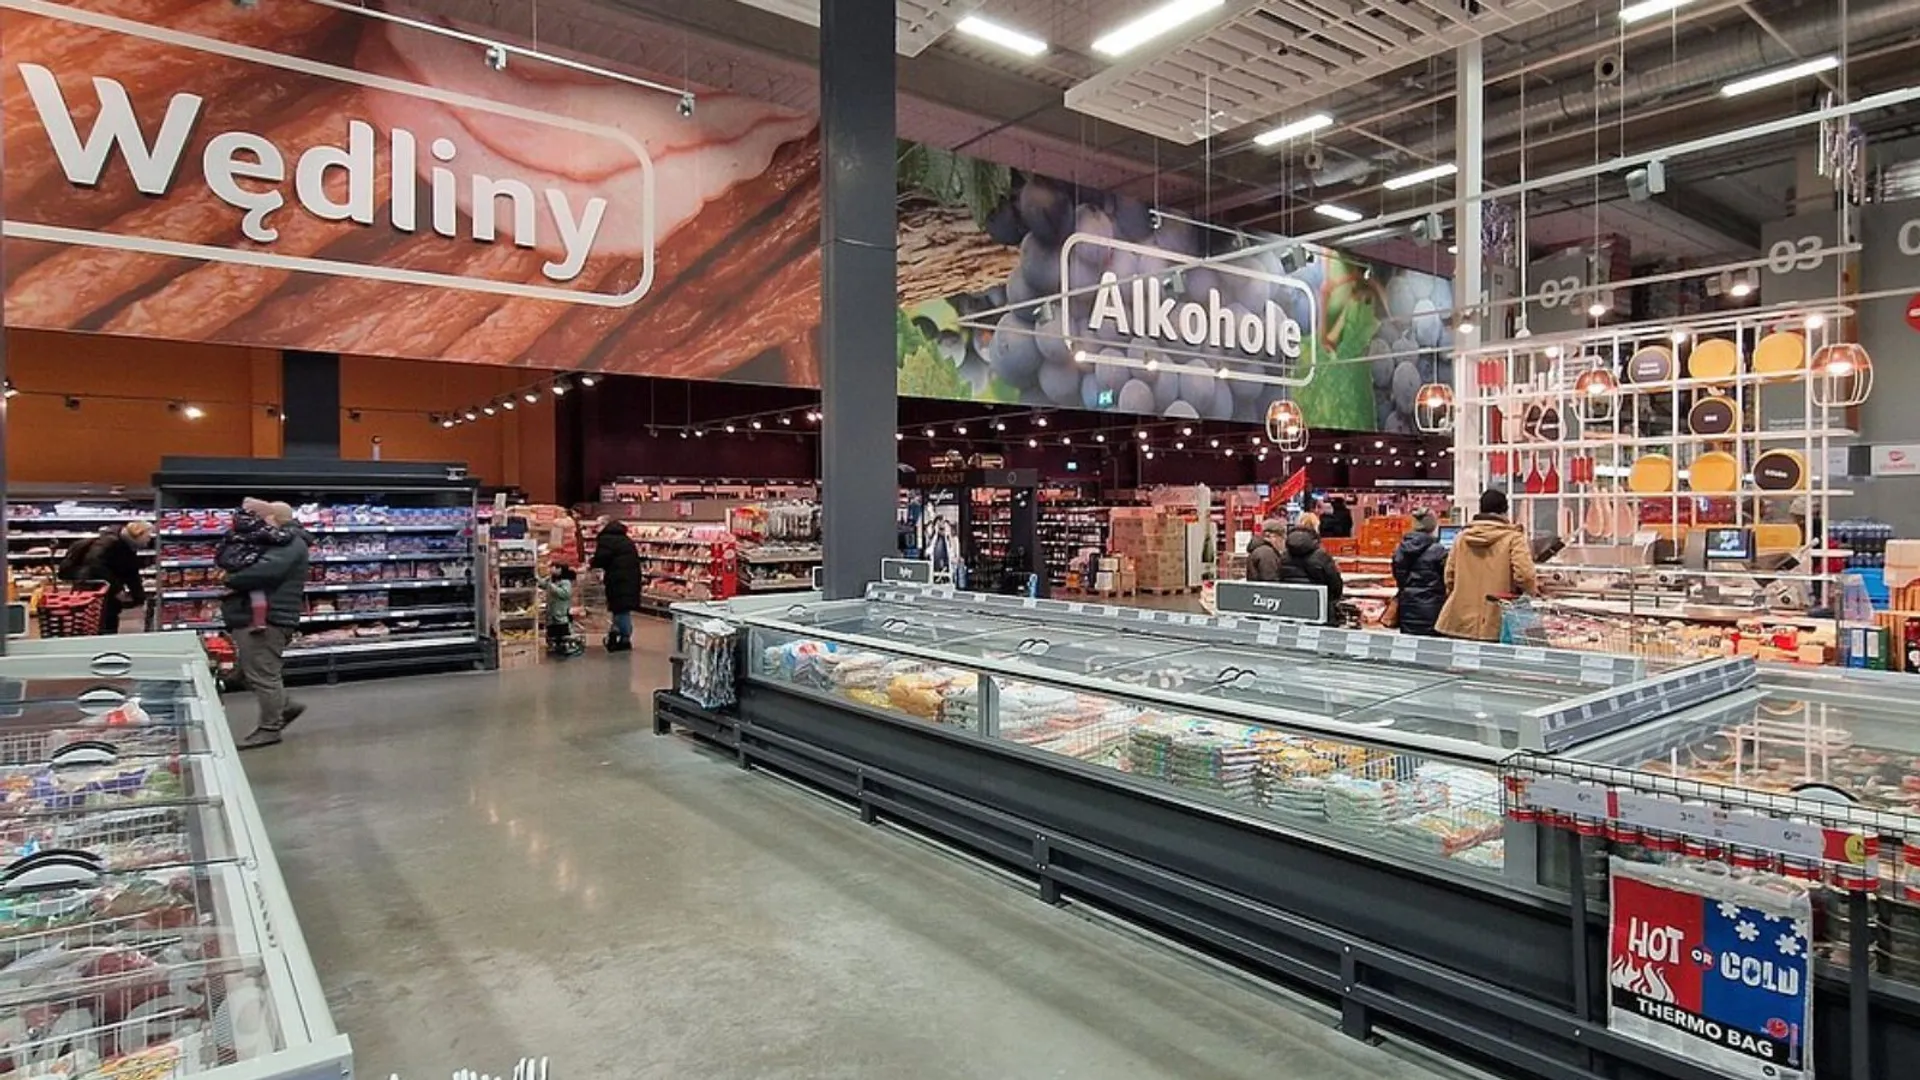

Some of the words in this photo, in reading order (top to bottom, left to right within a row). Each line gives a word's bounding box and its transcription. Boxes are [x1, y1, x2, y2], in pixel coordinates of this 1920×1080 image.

[18, 63, 607, 280] Wędliny
[1768, 235, 1824, 274] 03
[1089, 271, 1302, 359] Alkohole
[1540, 276, 1580, 308] 02
[1253, 593, 1281, 611] Zupy
[1628, 916, 1684, 965] HOT
[1691, 949, 1713, 966] OR
[1720, 952, 1799, 996] COLD
[1636, 997, 1722, 1040] THERMO
[1727, 1029, 1774, 1058] BAG
